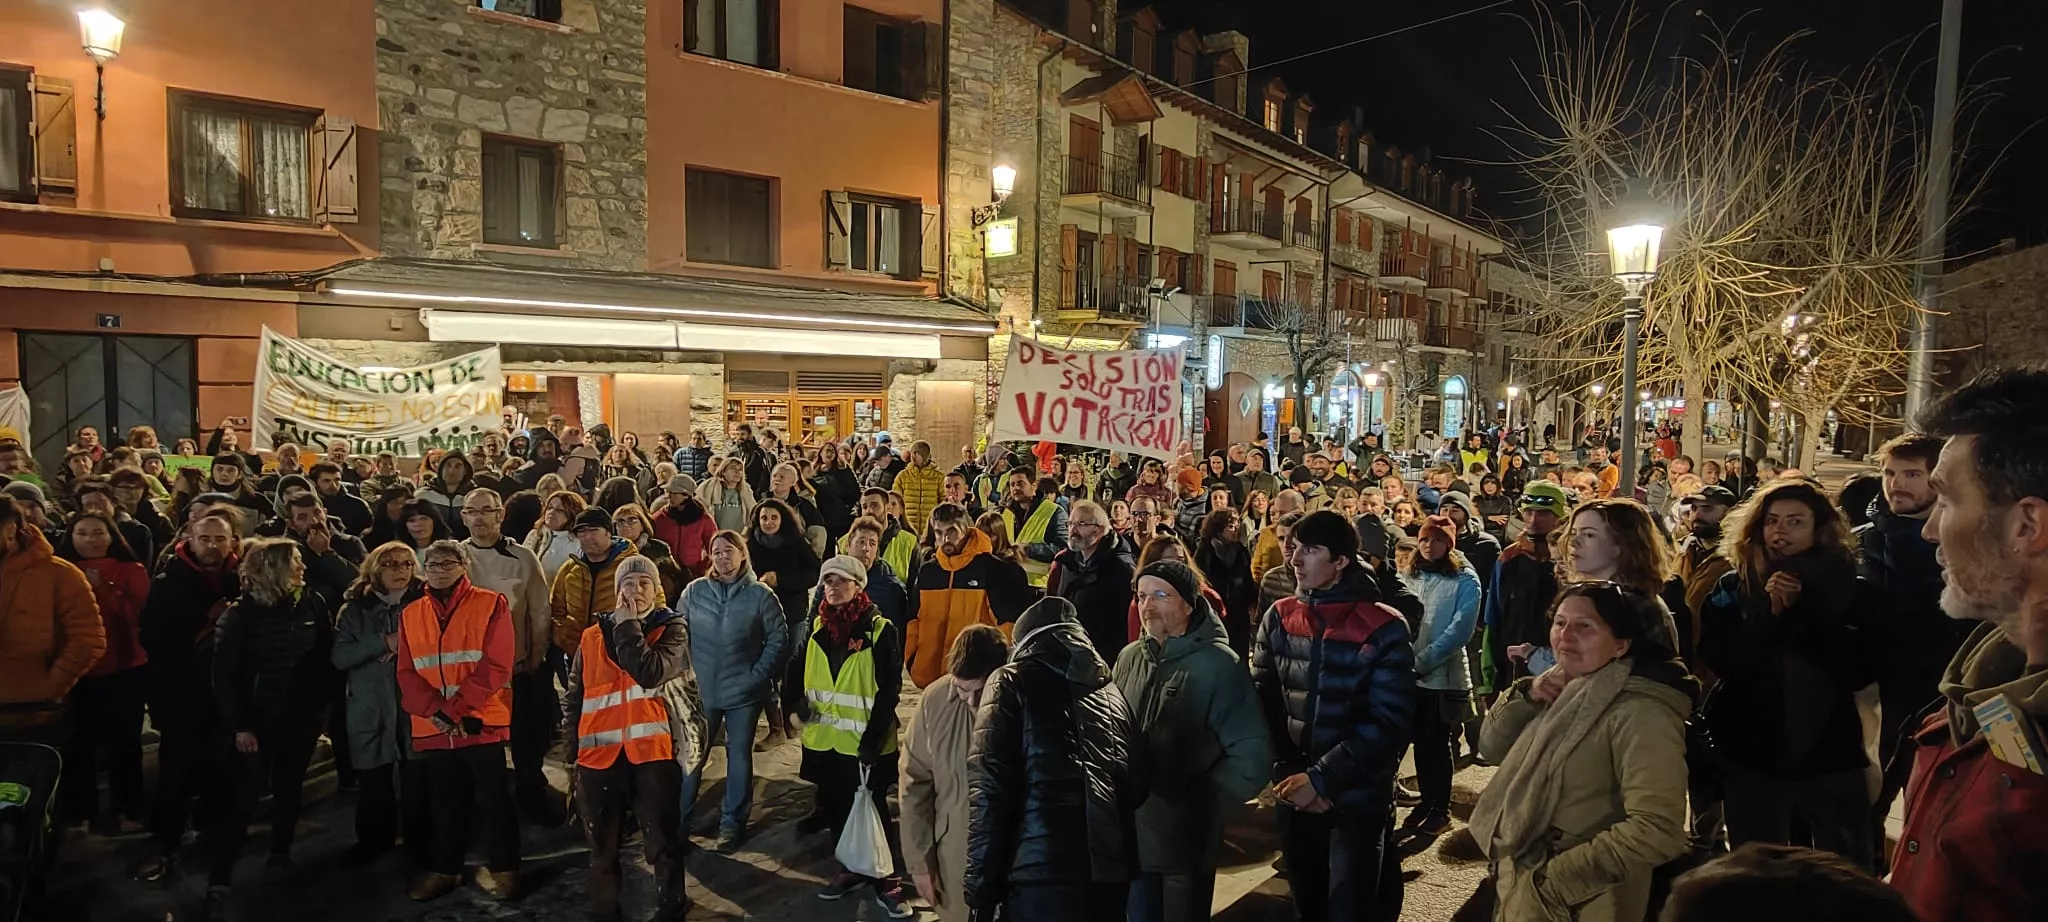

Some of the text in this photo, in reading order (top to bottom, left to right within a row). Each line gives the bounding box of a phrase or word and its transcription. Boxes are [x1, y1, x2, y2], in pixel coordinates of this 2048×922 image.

[104, 315, 114, 327] 7
[450, 357, 485, 385] DE
[401, 398, 436, 424] NO
[1118, 384, 1171, 414] TRAS
[1015, 391, 1175, 450] VOTACIÓN
